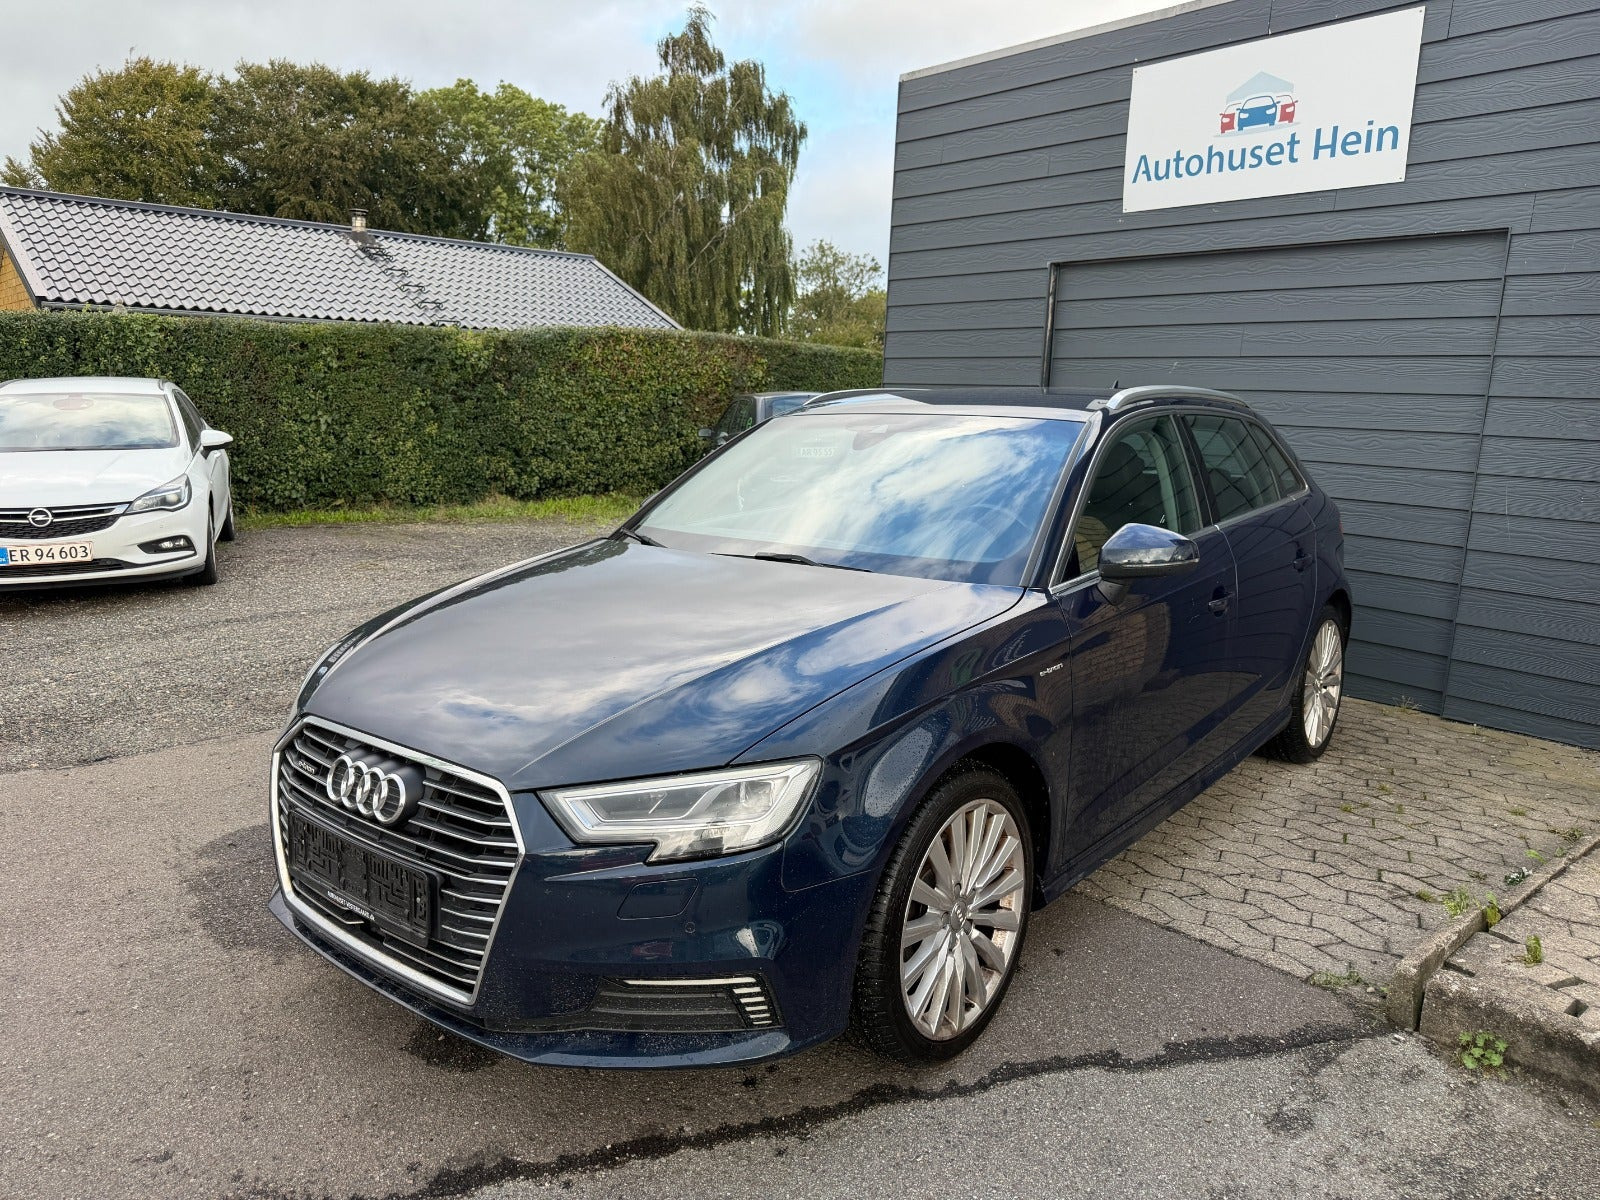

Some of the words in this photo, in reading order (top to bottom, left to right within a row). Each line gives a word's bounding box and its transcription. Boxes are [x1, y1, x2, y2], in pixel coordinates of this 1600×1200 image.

[1132, 132, 1300, 183] Autohuset
[1313, 120, 1399, 160] Hein
[9, 549, 30, 562] ER
[35, 548, 55, 561] 94
[59, 545, 88, 559] 603
[1040, 662, 1063, 676] e-tron
